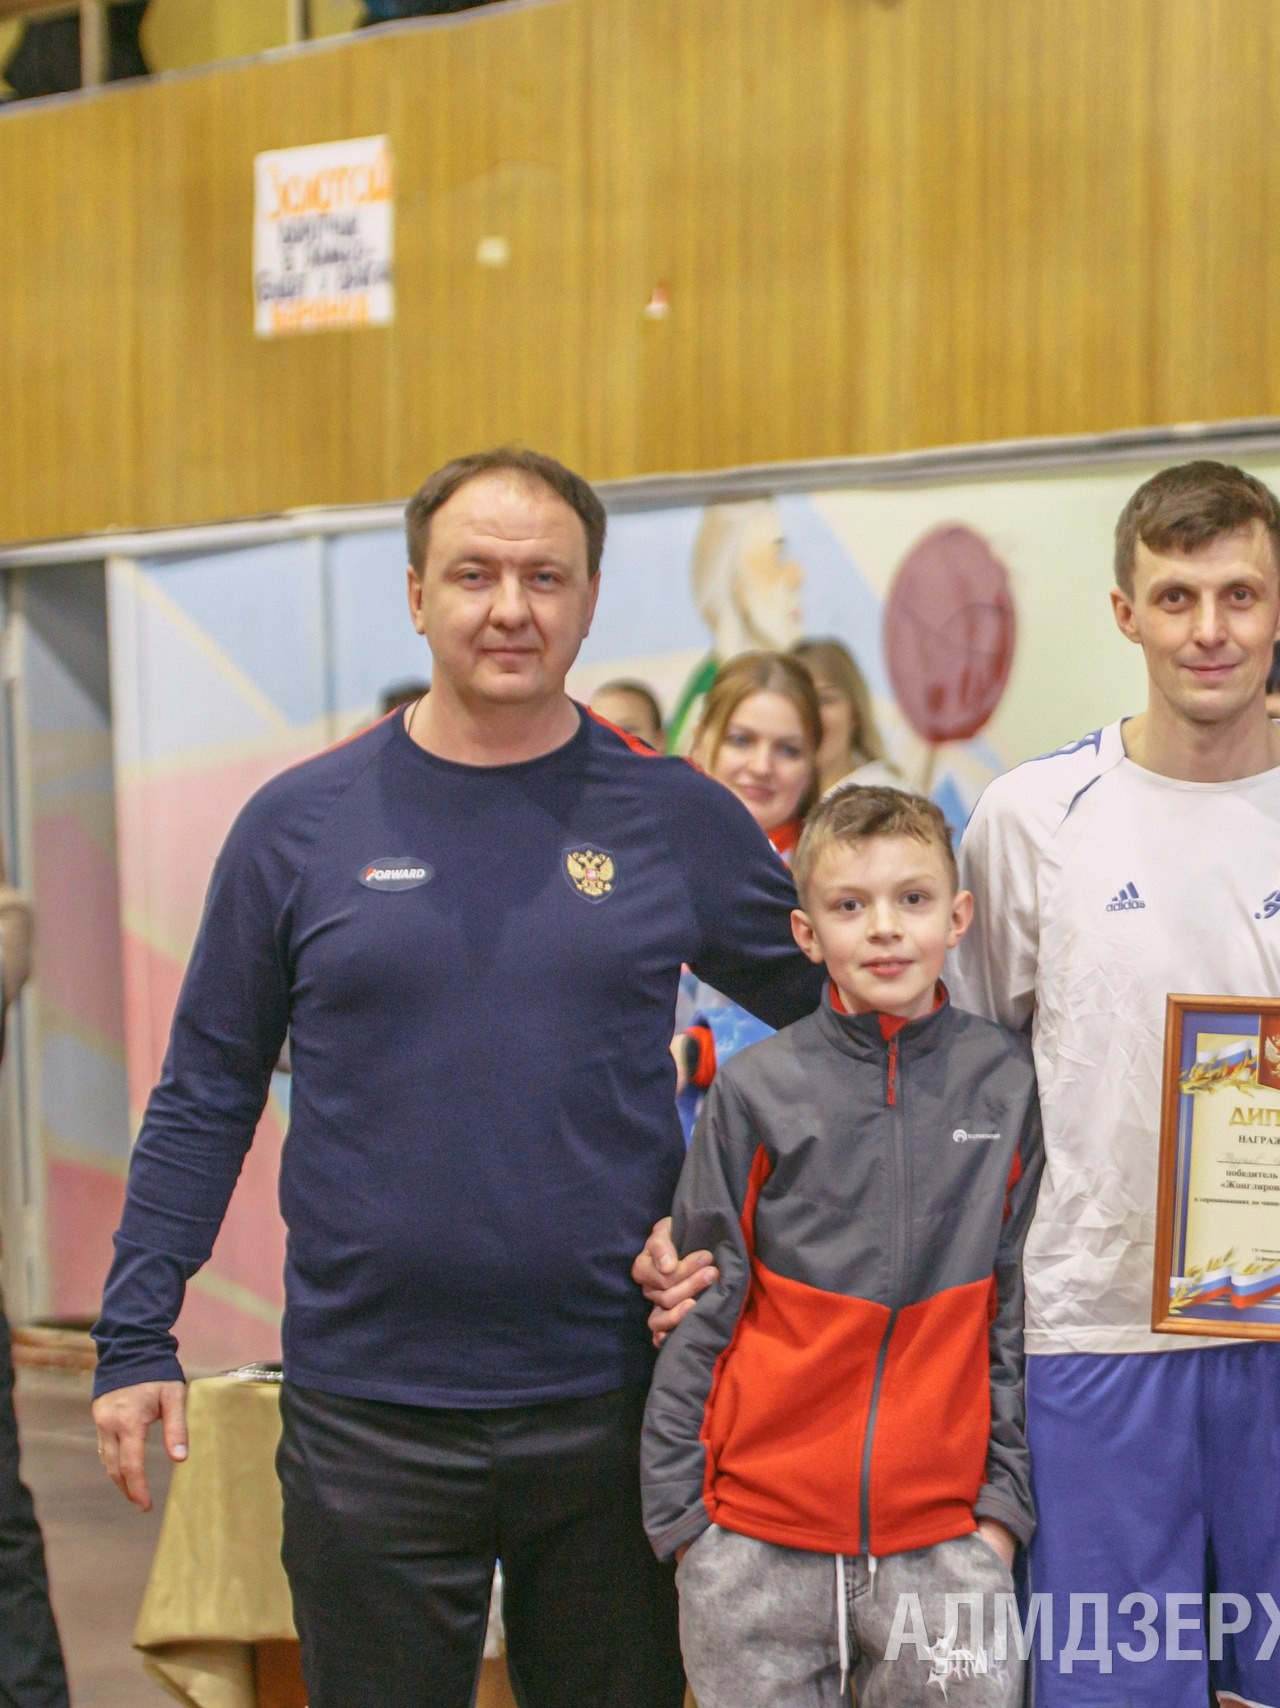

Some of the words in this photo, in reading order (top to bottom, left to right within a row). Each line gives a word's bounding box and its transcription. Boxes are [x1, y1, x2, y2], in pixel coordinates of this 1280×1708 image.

[365, 867, 425, 881] FORWARD
[1106, 900, 1146, 912] adidas
[1225, 1168, 1279, 1180] победитель
